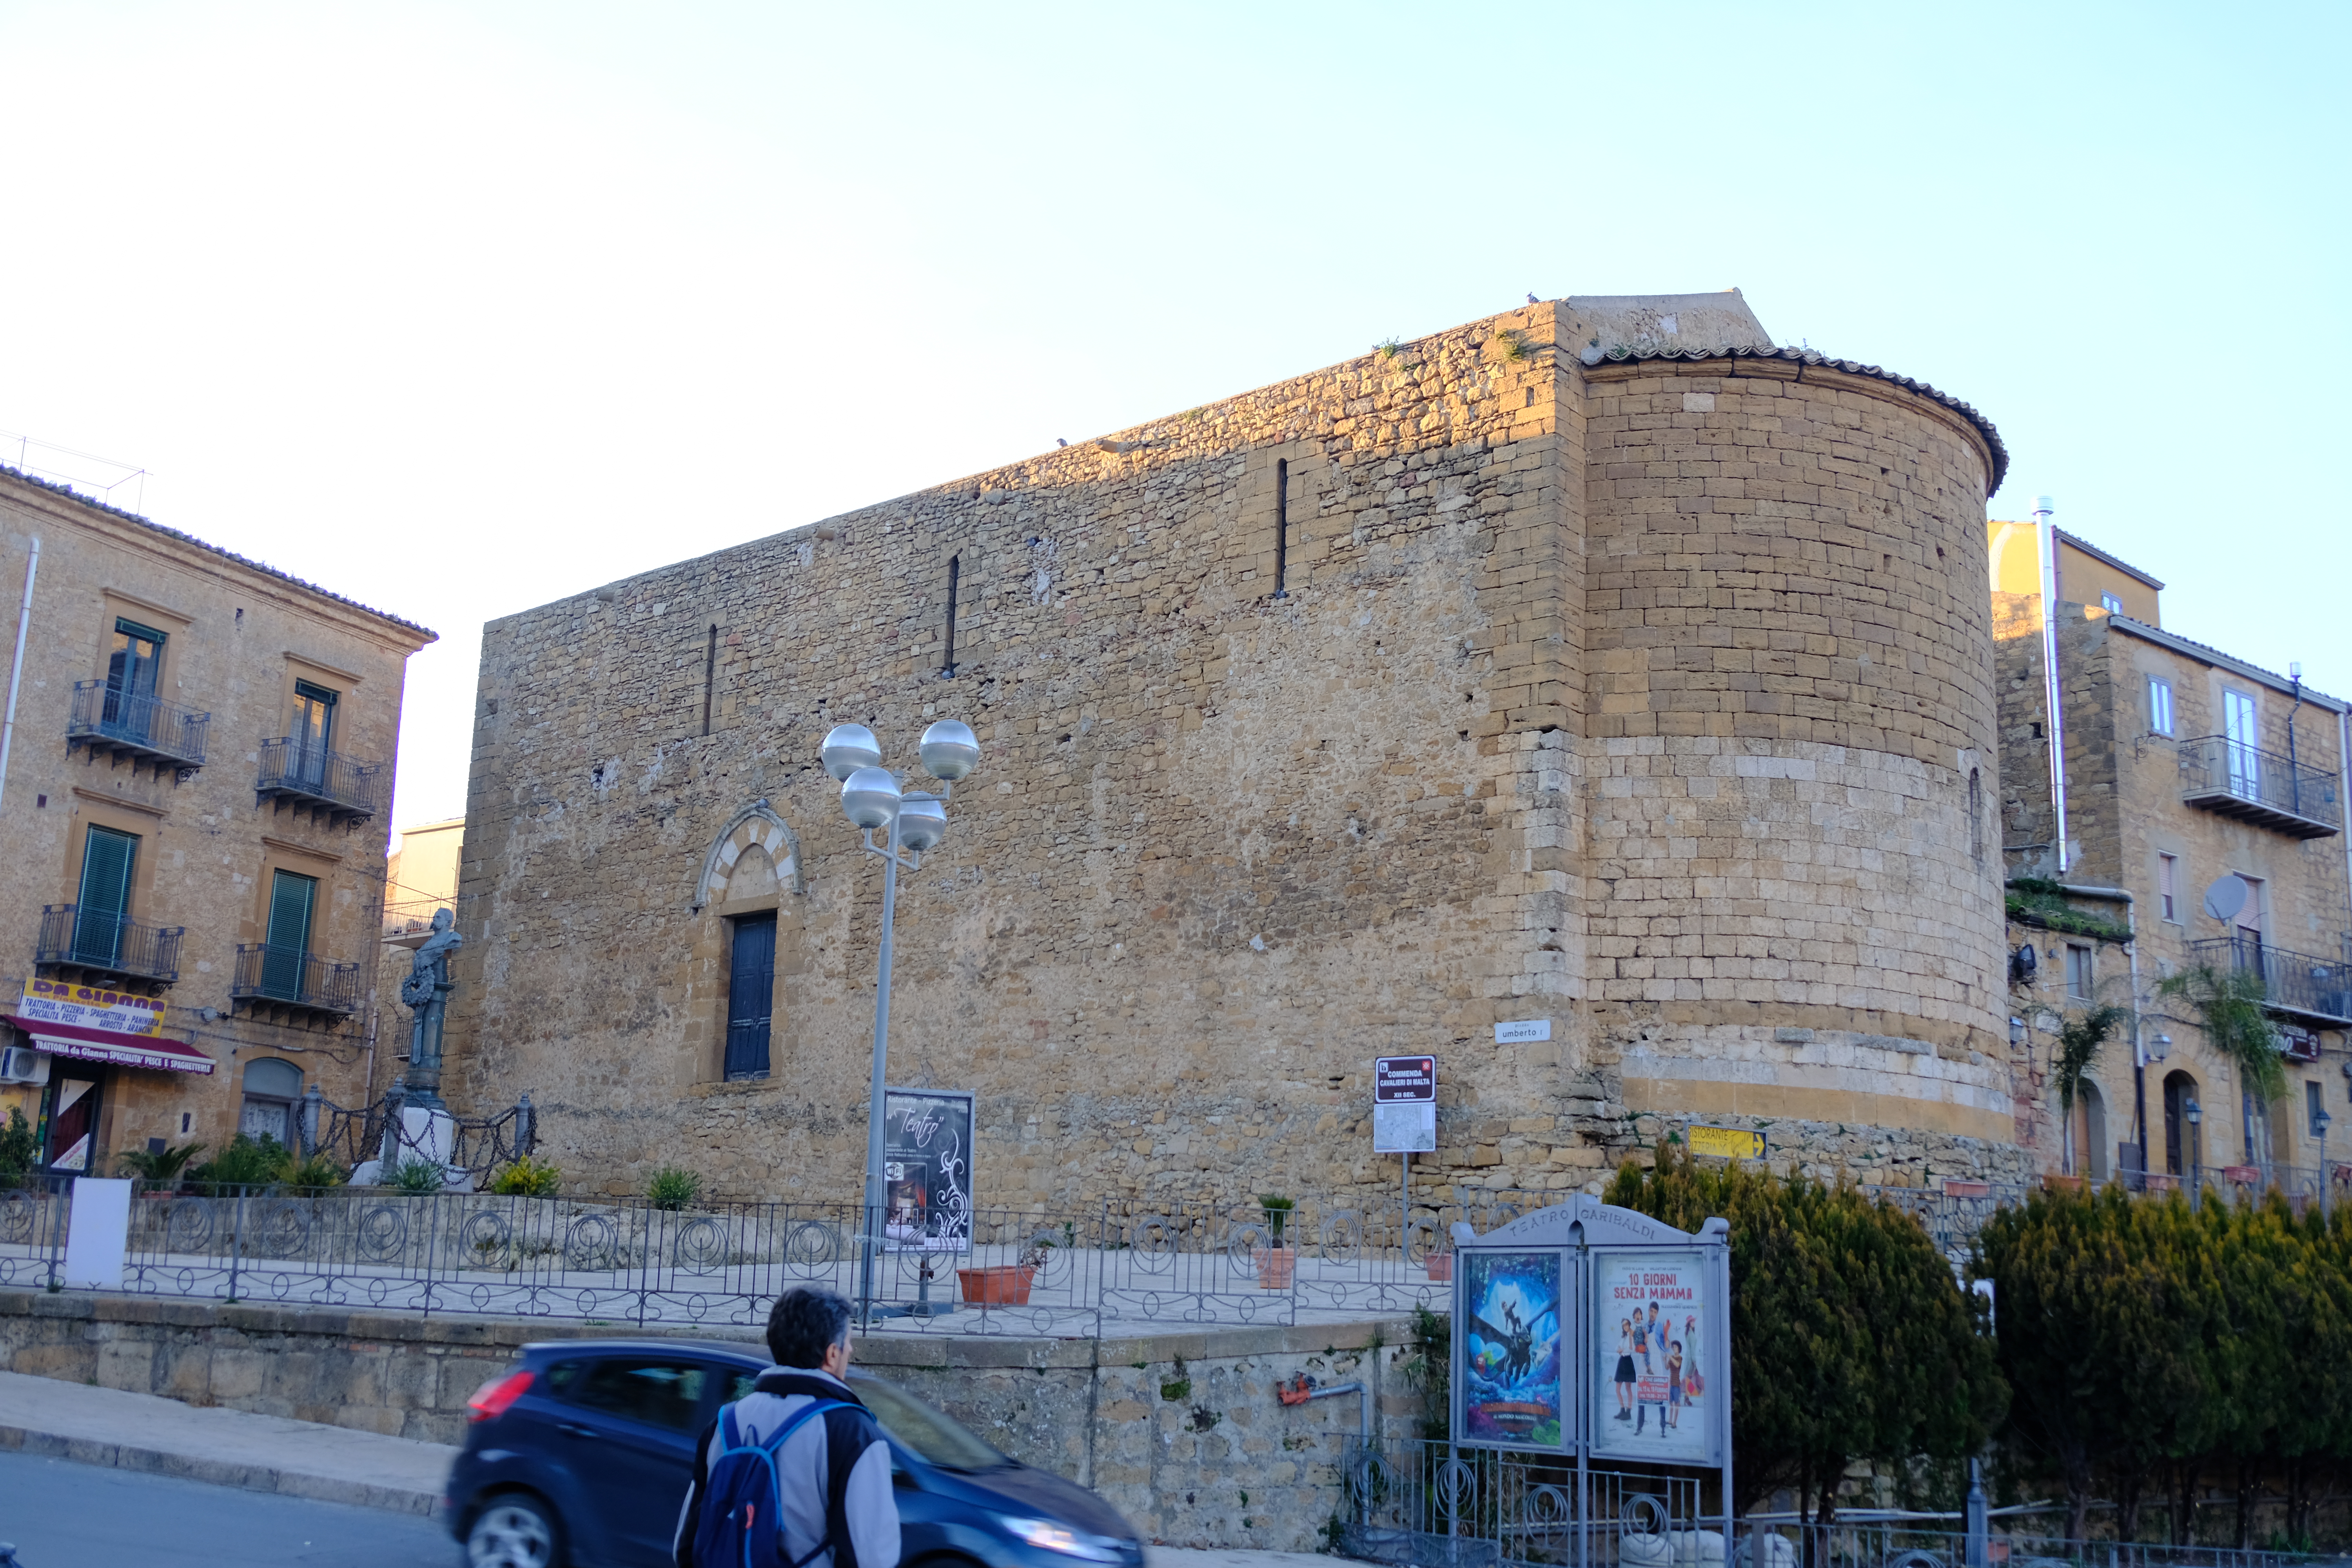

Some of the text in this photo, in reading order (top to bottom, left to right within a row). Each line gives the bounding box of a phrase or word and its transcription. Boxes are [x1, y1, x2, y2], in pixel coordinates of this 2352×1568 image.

[33, 980, 69, 996] DA
[25, 998, 56, 1010] TRATTORIA
[60, 1004, 85, 1015] PIZZERIA
[89, 1008, 127, 1022] SPAGHETTERIA
[131, 1015, 160, 1027] PANINERIA
[28, 1008, 59, 1020] SPECIALITA
[61, 1013, 78, 1023] PESCE
[99, 1019, 123, 1030] ARROSTO
[126, 1024, 153, 1034] ARANCINI
[1503, 1029, 1536, 1037] umberto
[36, 1040, 69, 1053] TRATTORIA
[70, 1046, 80, 1054] da
[81, 1047, 108, 1058] Gianna
[145, 1056, 162, 1066] PESCE
[171, 1060, 211, 1073] SPAGHETTERIA
[1388, 1070, 1423, 1078] COMMENDA
[1380, 1079, 1406, 1087] CAVALIERI
[887, 1095, 918, 1105] Ristorante
[923, 1098, 944, 1106] Pizzeria
[1688, 1126, 1727, 1141] RISTORANTE
[1688, 1140, 1717, 1152] PIZZERIA
[1510, 1209, 1655, 1240] TEATRO GARIBALDI
[1629, 1273, 1676, 1286] 10 GIORNI
[1614, 1287, 1692, 1299] SENZA MAMMA
